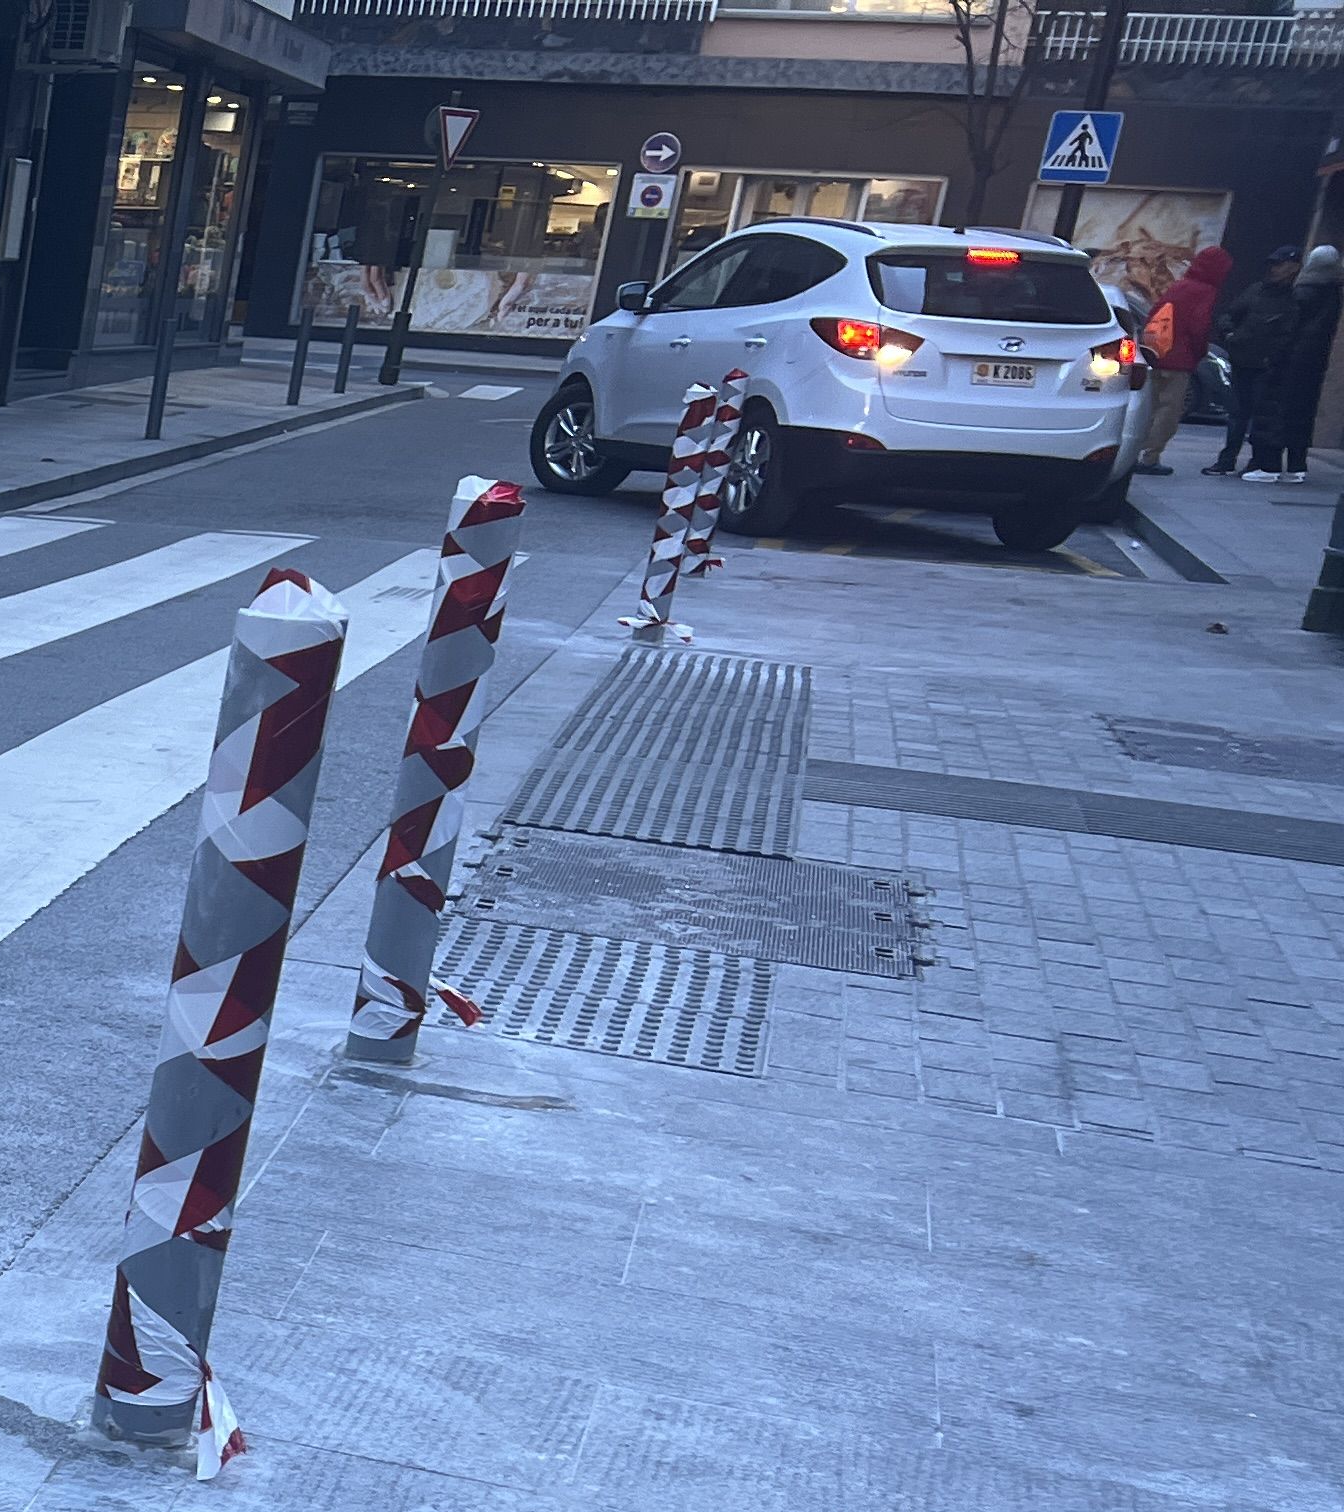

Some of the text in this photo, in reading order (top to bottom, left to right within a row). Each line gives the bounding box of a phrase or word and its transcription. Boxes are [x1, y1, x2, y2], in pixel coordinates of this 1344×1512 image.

[526, 317, 551, 329] per
[552, 318, 561, 328] a
[993, 364, 1001, 378] K
